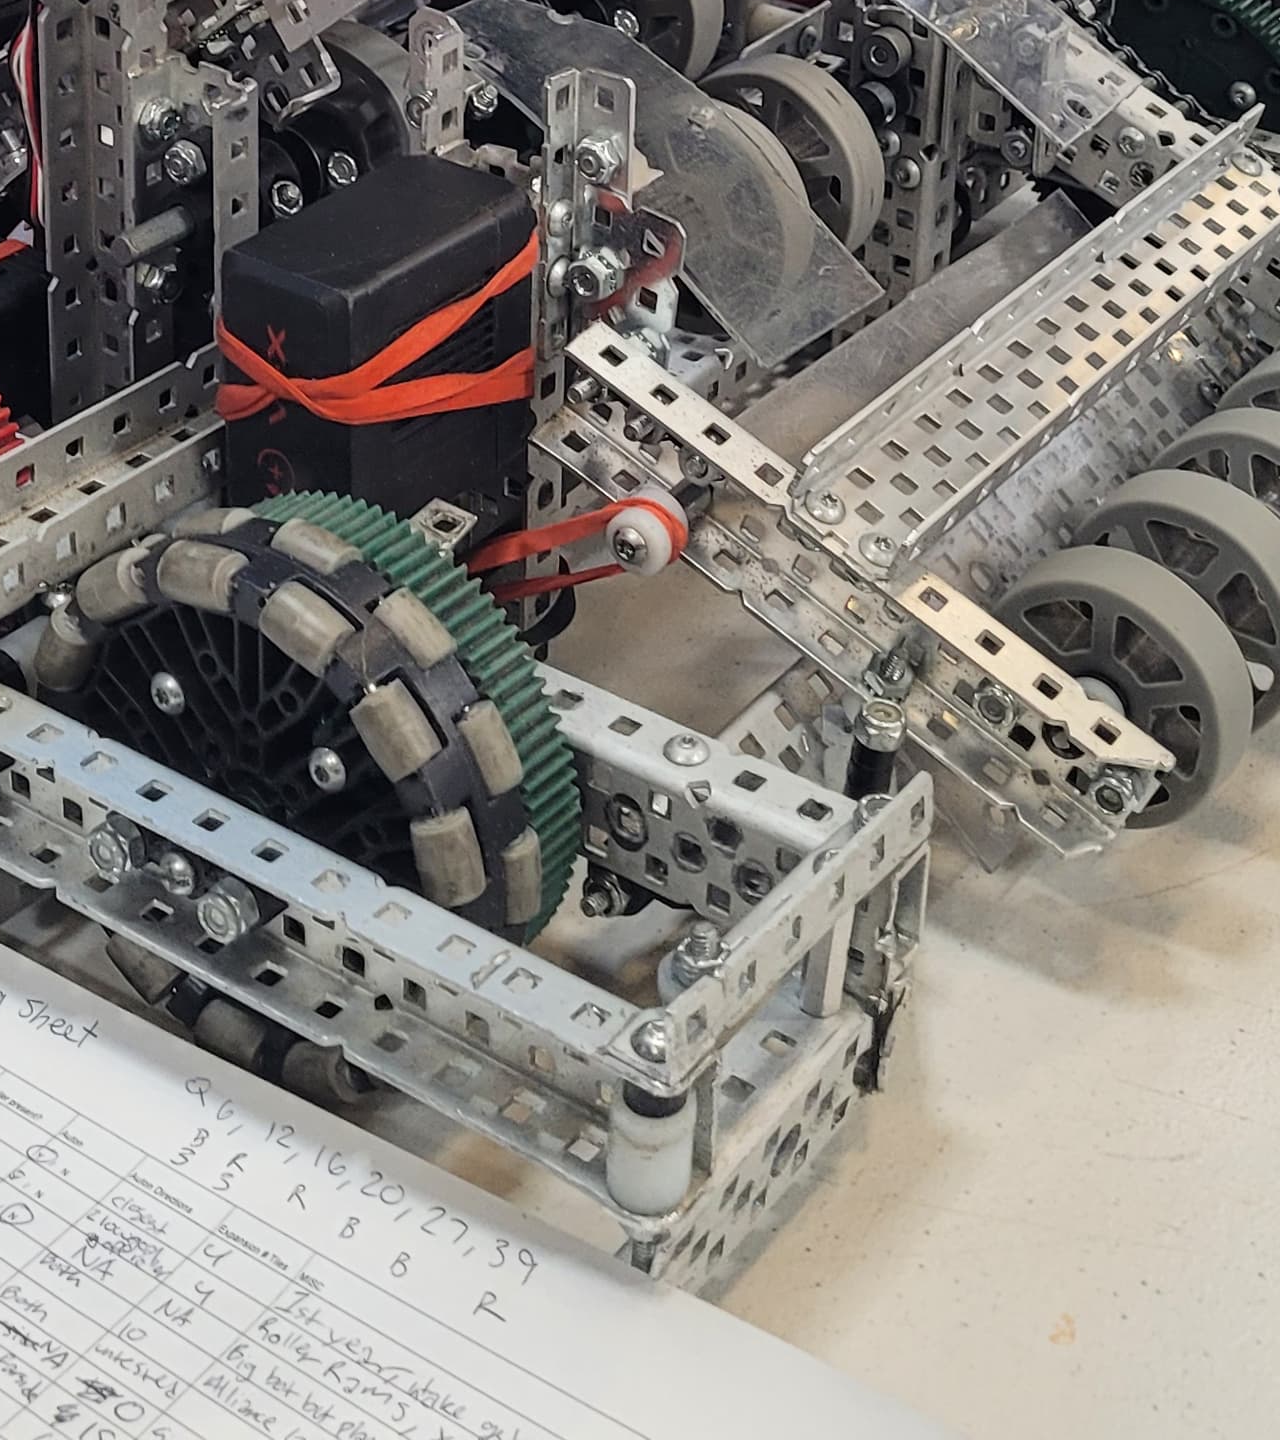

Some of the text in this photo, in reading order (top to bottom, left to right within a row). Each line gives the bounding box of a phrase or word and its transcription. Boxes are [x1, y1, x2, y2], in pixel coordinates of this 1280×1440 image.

[19, 999, 99, 1048] Sheet
[152, 1186, 193, 1214] Directions
[218, 1224, 261, 1255] Expansion
[489, 1239, 539, 1285] 39
[339, 1217, 360, 1239] B
[390, 1252, 411, 1277] B
[473, 1291, 506, 1322] R
